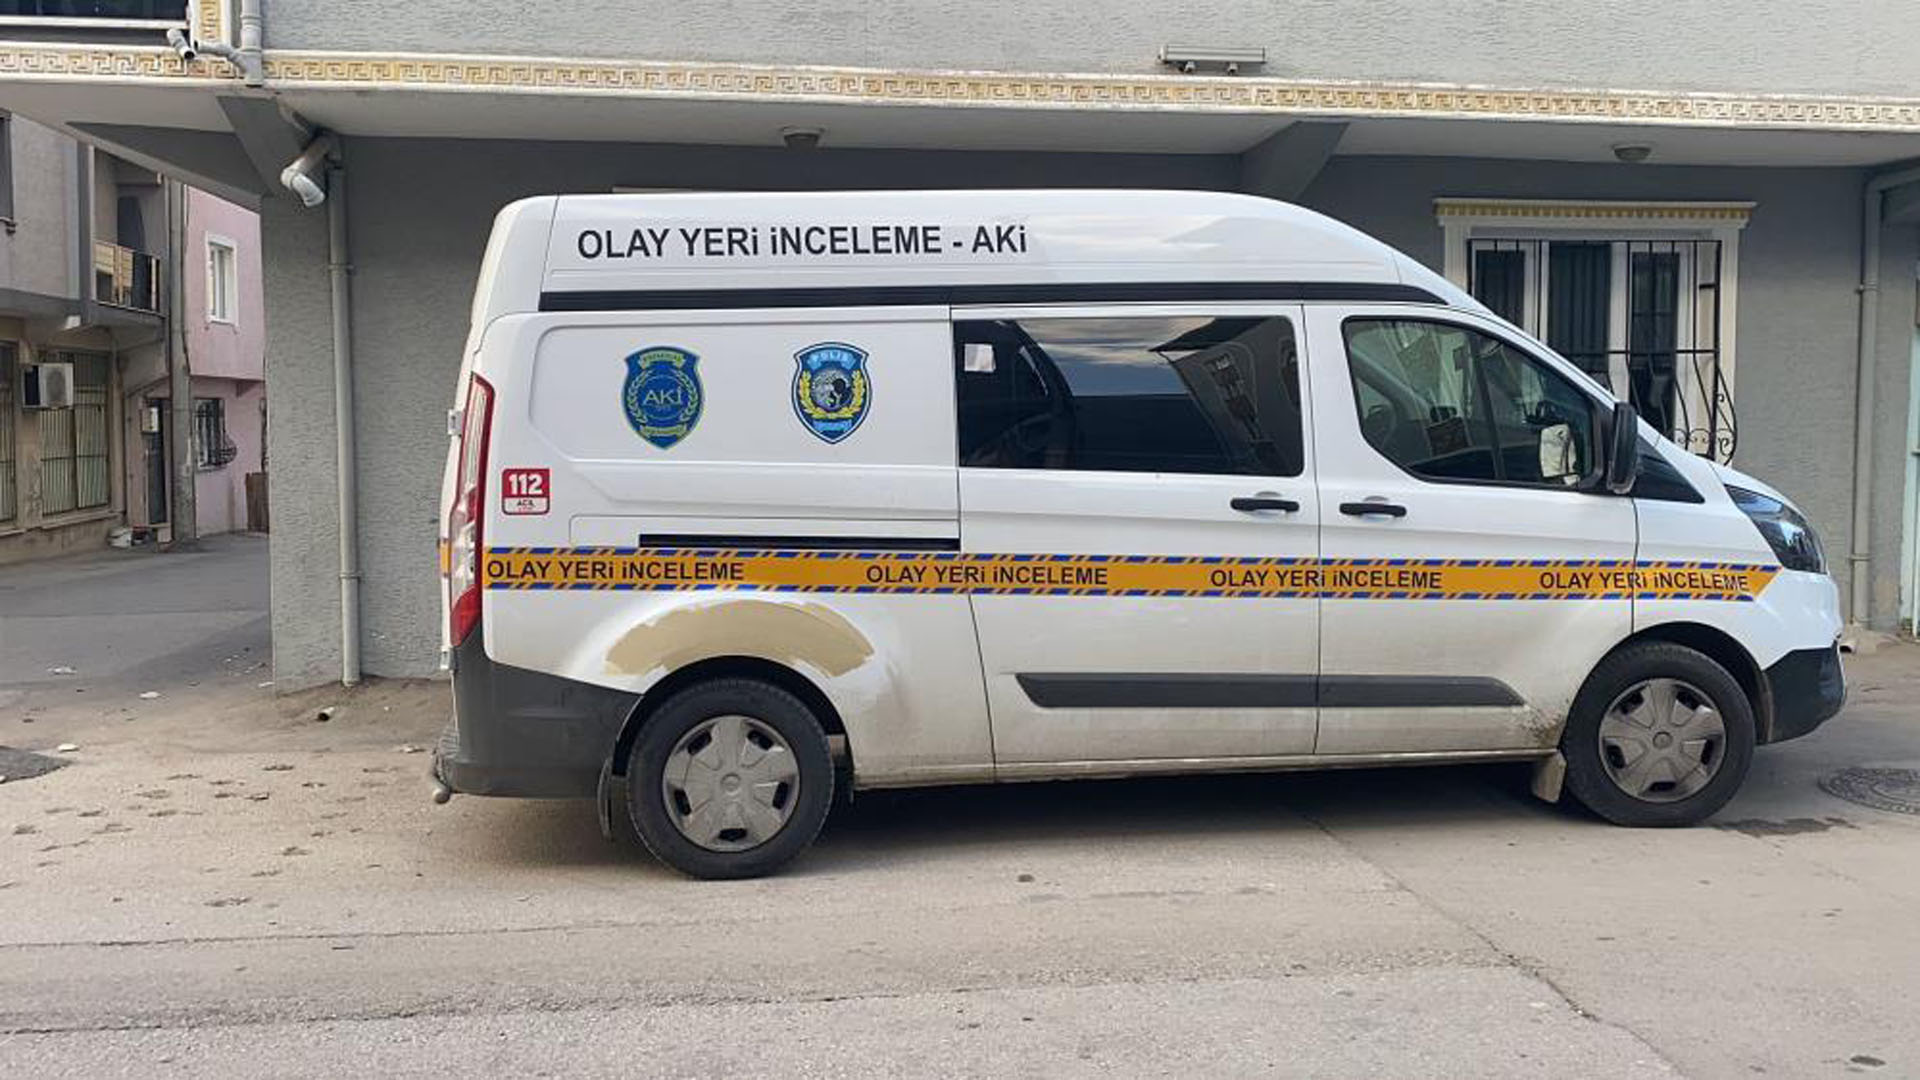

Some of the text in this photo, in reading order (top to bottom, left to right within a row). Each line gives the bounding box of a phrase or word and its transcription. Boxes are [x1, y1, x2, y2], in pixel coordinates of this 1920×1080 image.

[577, 228, 670, 259] OLAY
[508, 472, 543, 495] 112
[486, 560, 551, 579] OLAY
[866, 564, 927, 583] OLAY
[1210, 569, 1268, 588] OLAY
[1539, 571, 1593, 589] OLAY
